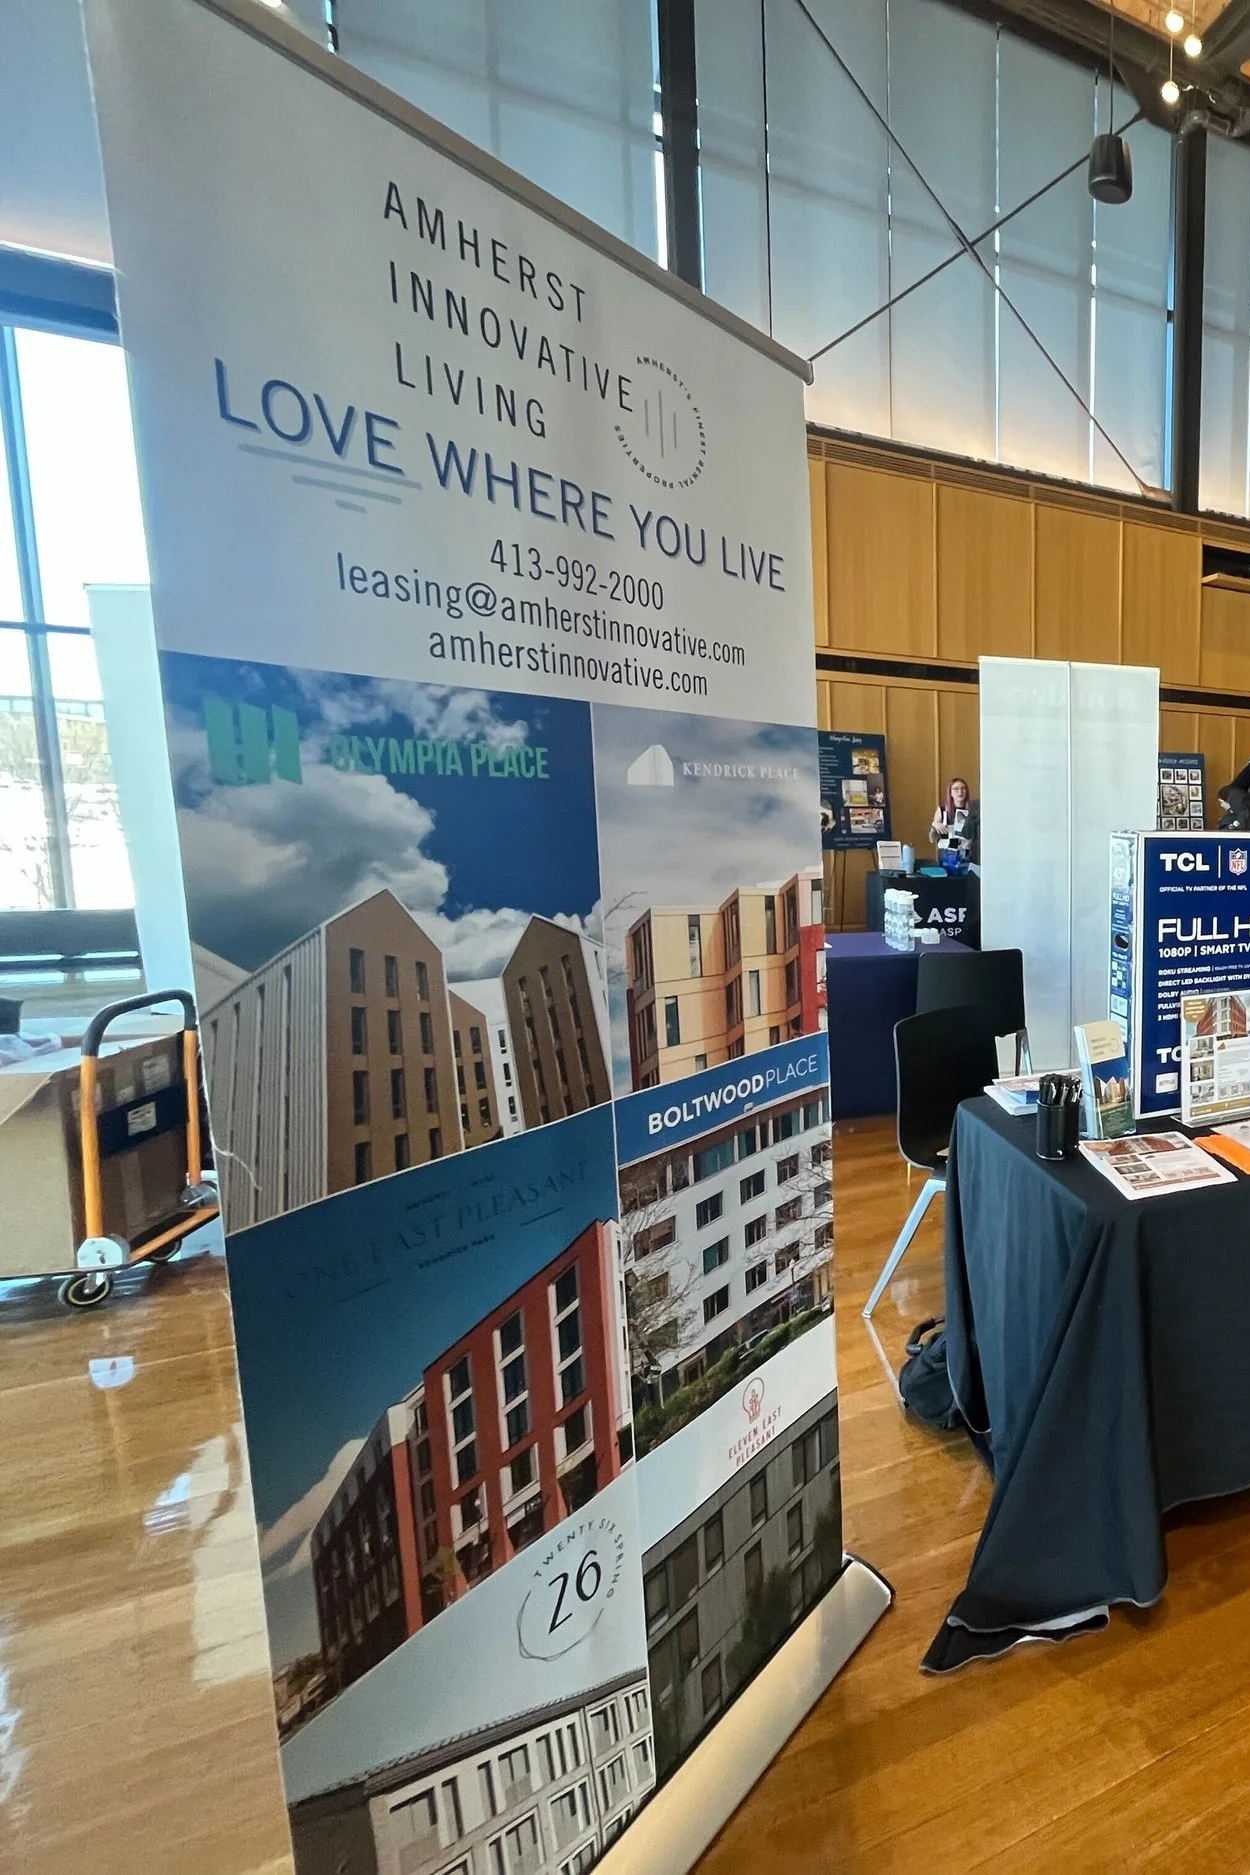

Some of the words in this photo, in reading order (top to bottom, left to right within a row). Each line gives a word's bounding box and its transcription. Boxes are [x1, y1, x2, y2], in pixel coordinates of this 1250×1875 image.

[384, 181, 586, 322] AMHERST
[389, 261, 634, 413] INNOVATIVE
[395, 342, 547, 439] LIVING
[213, 357, 404, 476] LOVE
[425, 432, 616, 541] WHERE
[629, 504, 707, 568] YOU
[721, 535, 787, 593] LIVE
[490, 539, 665, 611] 413-992-2000
[337, 552, 746, 668] leasing@amherstinnovative.com
[428, 629, 709, 696] amherstinnovative.com
[326, 734, 463, 776] OLYMPIA
[470, 740, 550, 779] PLACE
[683, 762, 755, 779] KENDRICK
[760, 766, 800, 781] PLACE
[1160, 852, 1210, 872] TCL
[1231, 859, 1245, 870] NFL
[1158, 916, 1229, 942] FULL
[1159, 946, 1192, 958] 1080P
[1200, 943, 1235, 955] SMART
[1238, 942, 1250, 953] TV
[1157, 991, 1179, 999] DOLBY
[1158, 968, 1176, 976] ROKU
[1177, 965, 1211, 974] STREAMING
[1194, 975, 1226, 984] BACKLIGHT
[1227, 973, 1243, 981] WITH
[728, 1426, 758, 1459] ELEVEN
[762, 1405, 782, 1430] EAST
[736, 1425, 775, 1467] PLEASANT
[533, 1519, 595, 1578] TWENTY
[599, 1518, 617, 1534] SIX
[548, 1549, 602, 1636] 26
